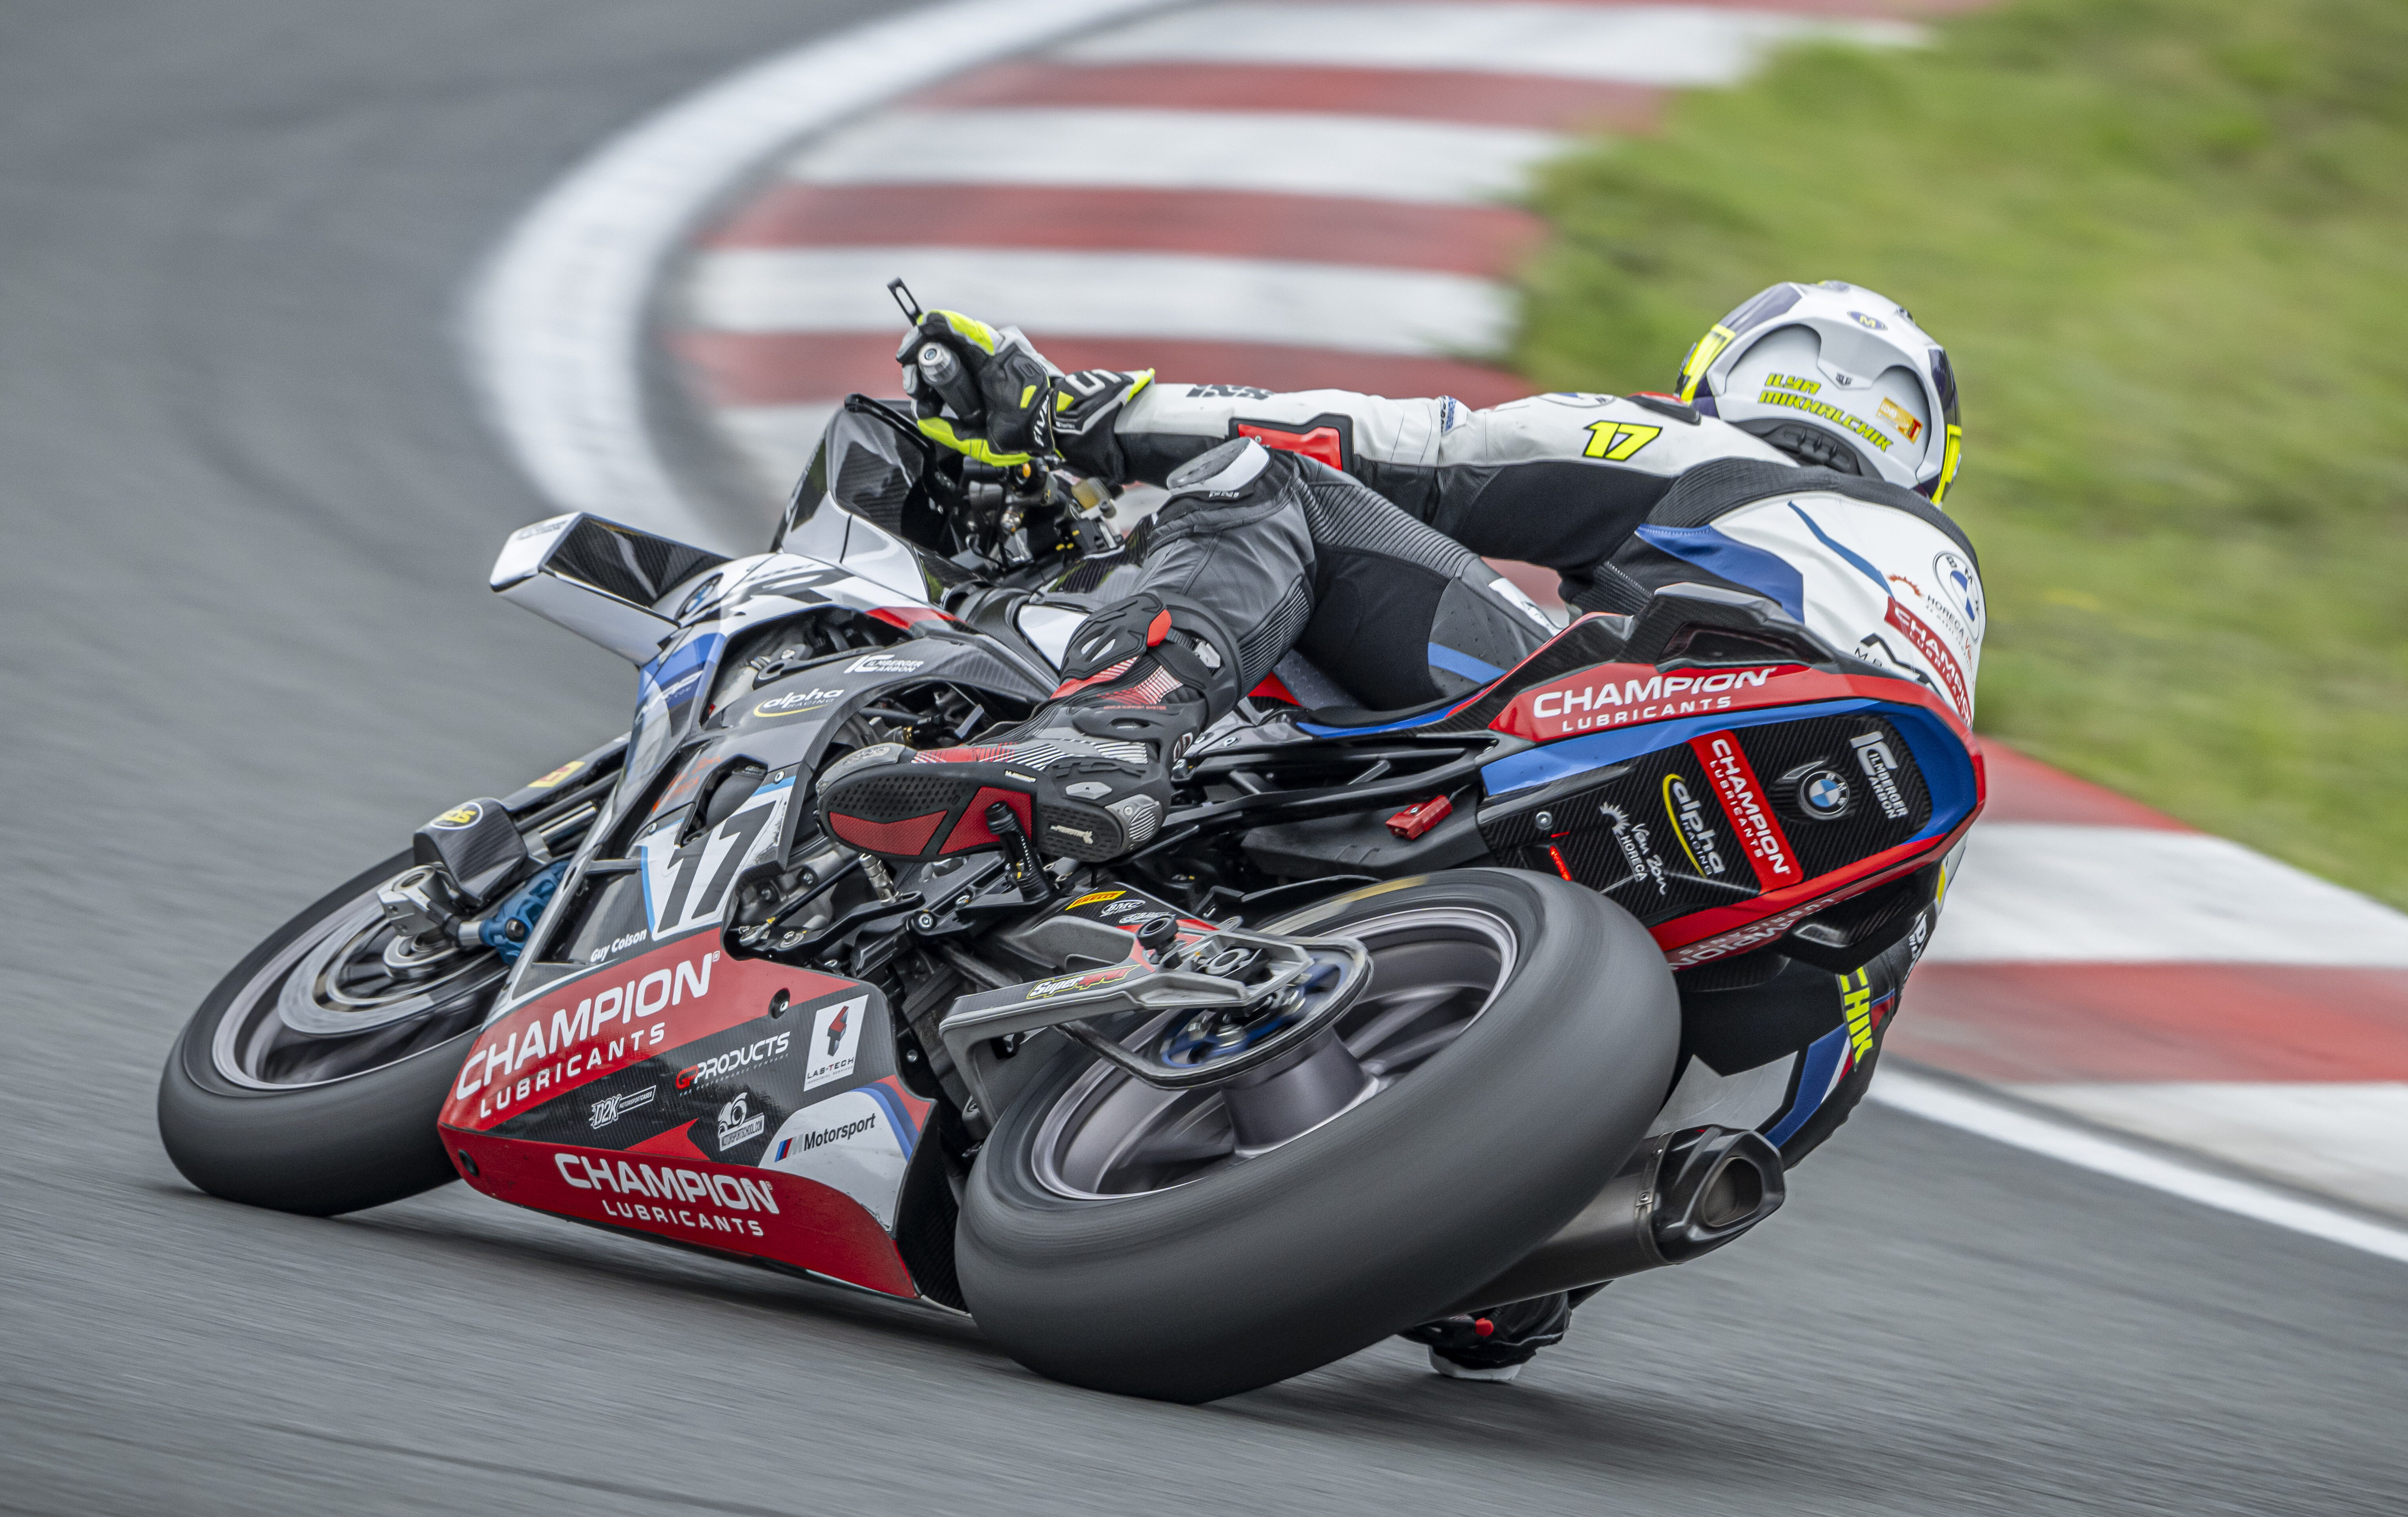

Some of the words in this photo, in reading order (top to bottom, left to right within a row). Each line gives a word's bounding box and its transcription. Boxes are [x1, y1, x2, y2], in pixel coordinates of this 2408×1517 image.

[1766, 372, 1821, 395] ILYA
[1582, 419, 1663, 461] 17
[1758, 390, 1893, 452] MIKHALCHIK
[763, 688, 845, 709] alpha
[1562, 697, 1731, 732] LUBRICANTS
[1672, 782, 1726, 875] alpha
[1709, 760, 1764, 858] LUBRICANTS
[657, 800, 777, 933] 17
[1683, 822, 1711, 876] RACING
[1107, 903, 1139, 911] BMC
[591, 946, 610, 963] Guy
[611, 929, 647, 952] Colson
[481, 1022, 665, 1118] LUBRICANTS
[807, 1057, 854, 1079] LAS-TECH
[804, 1112, 876, 1151] Motorsport
[602, 1200, 764, 1237] LUBRICANTS
